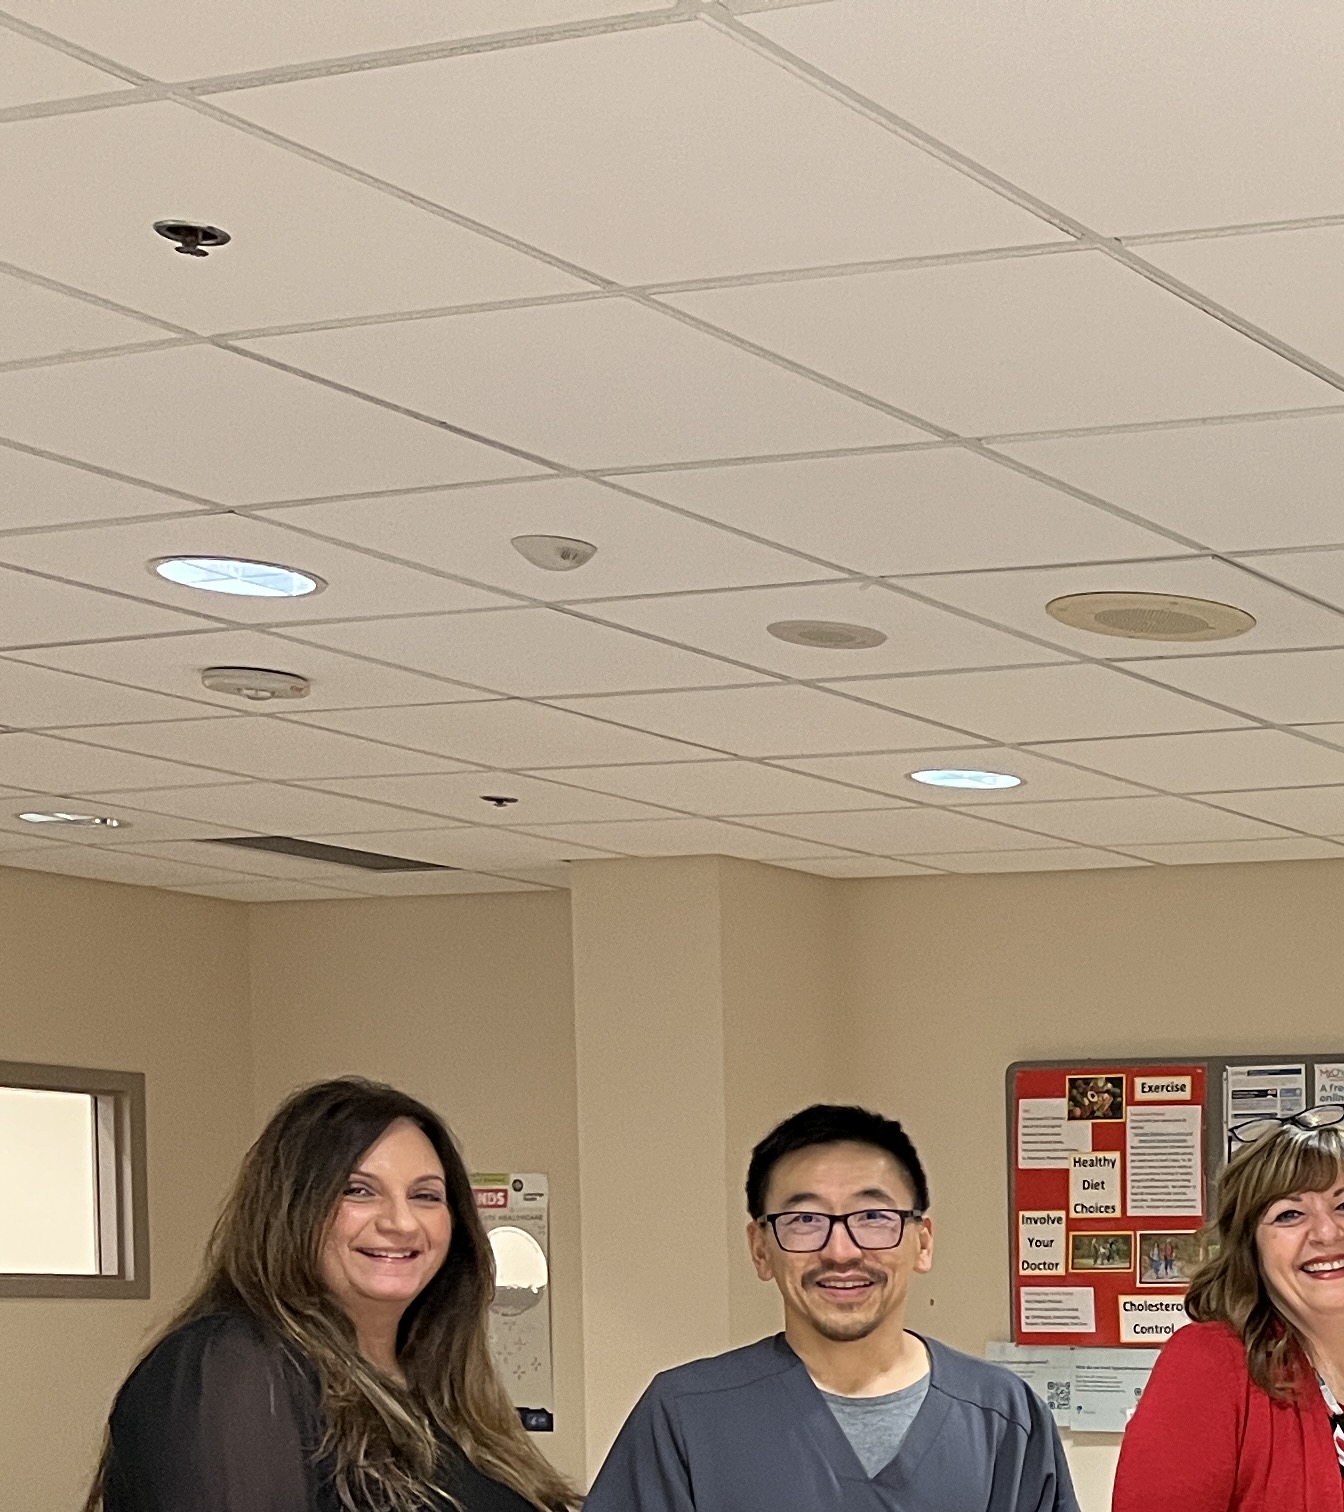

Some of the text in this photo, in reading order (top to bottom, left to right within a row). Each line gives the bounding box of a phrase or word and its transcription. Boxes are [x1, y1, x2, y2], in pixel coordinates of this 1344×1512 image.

[1141, 1082, 1186, 1094] Exercise
[1320, 1084, 1327, 1092] A
[1073, 1156, 1116, 1169] Healthy
[1082, 1179, 1105, 1190] Diet
[1074, 1203, 1116, 1214] Choices
[1021, 1214, 1063, 1225] Involve
[1028, 1237, 1054, 1248] Your
[1021, 1260, 1060, 1271] Doctor
[1123, 1301, 1184, 1312] Cholestero
[1133, 1323, 1175, 1335] Control
